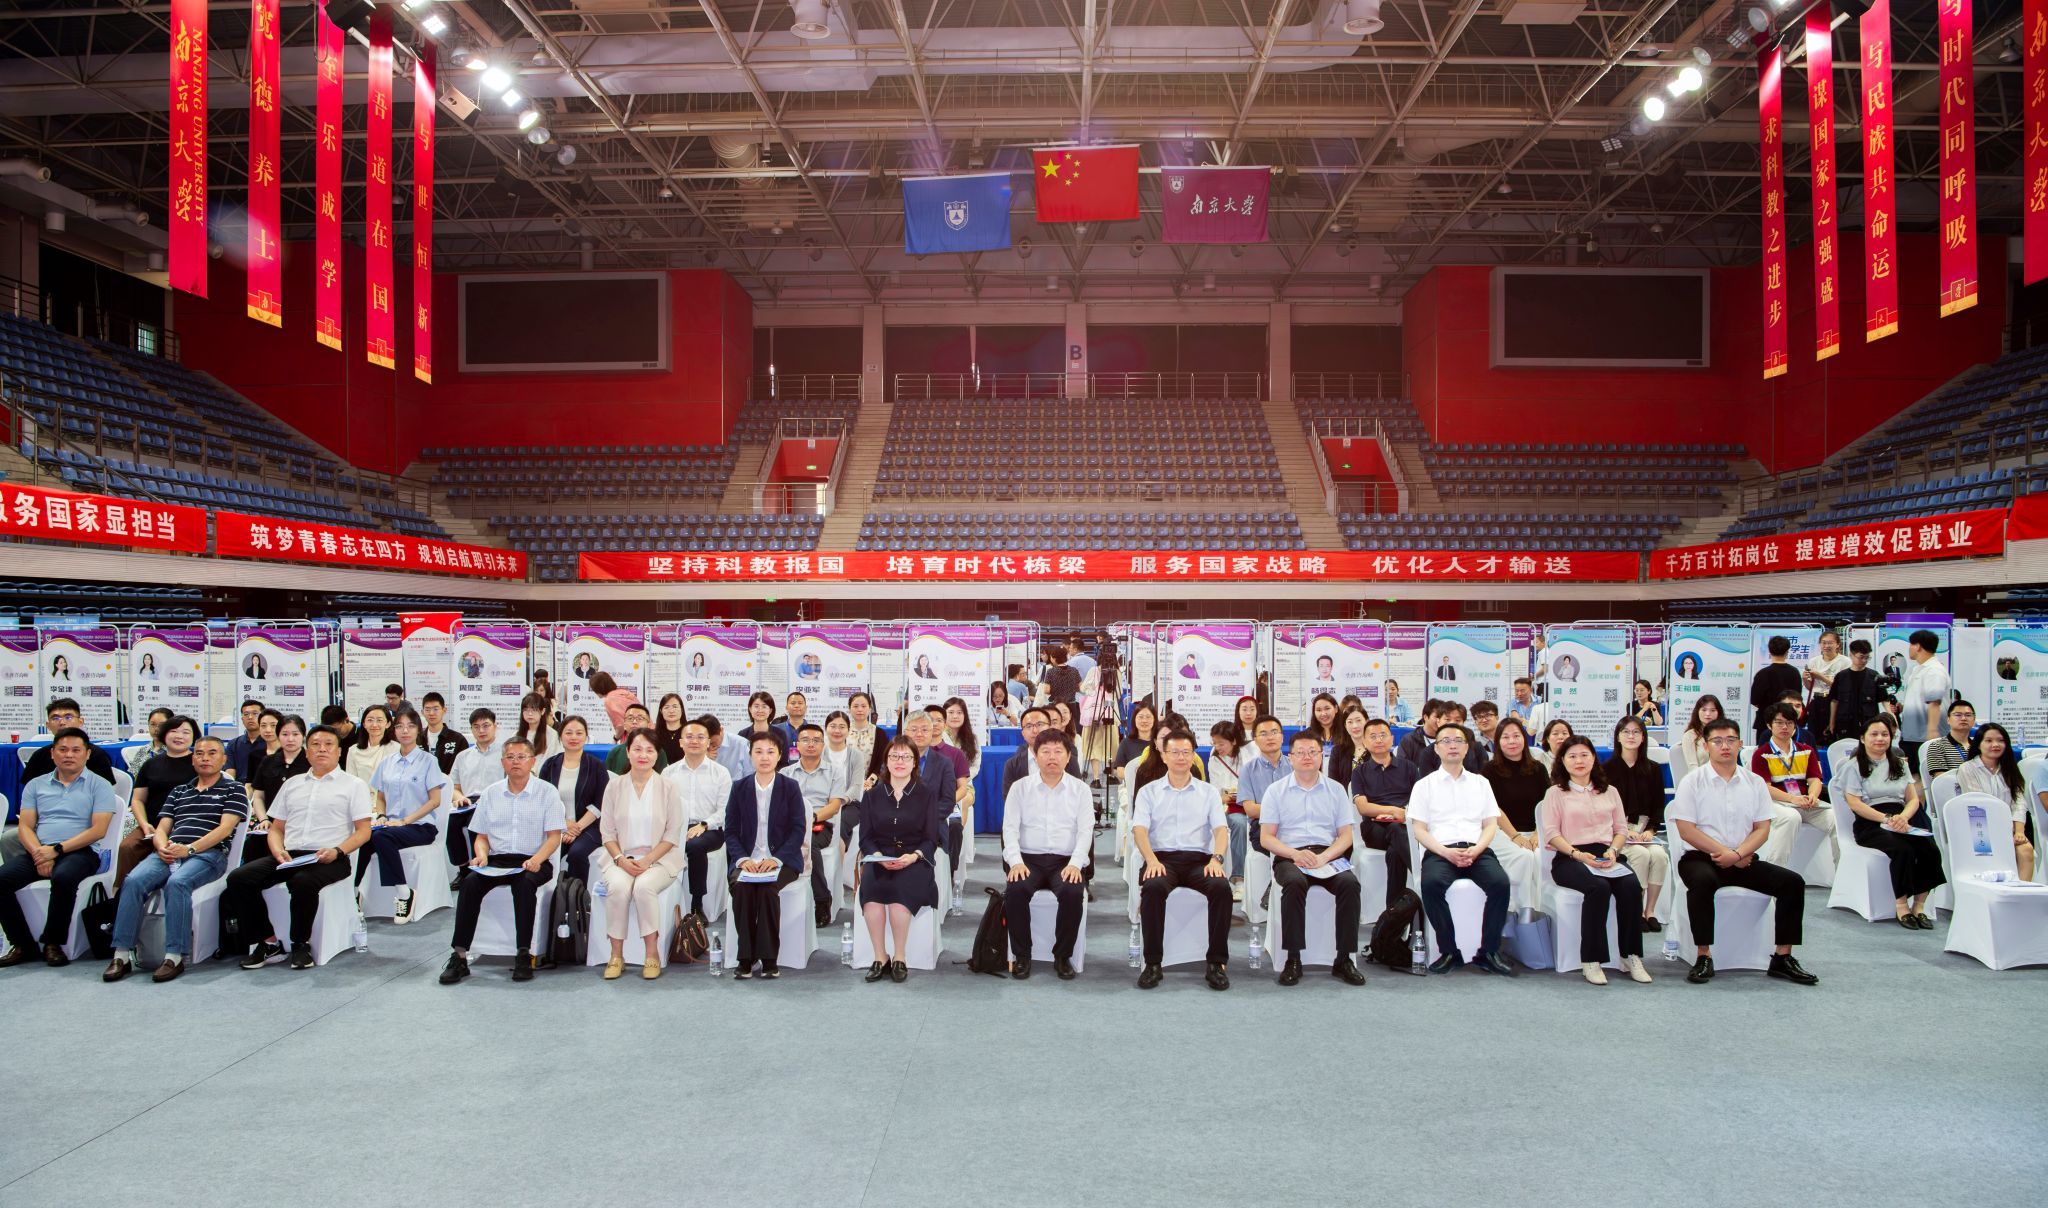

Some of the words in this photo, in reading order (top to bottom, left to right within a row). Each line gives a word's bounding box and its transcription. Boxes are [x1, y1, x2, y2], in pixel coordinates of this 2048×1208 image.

[192, 28, 204, 110] NANJING
[193, 115, 205, 226] UNIVERSITY
[371, 90, 388, 314] 吾道在国
[1813, 78, 1834, 305] 谋国家之强盛
[1867, 42, 1891, 281] 与民族共命运
[416, 122, 429, 332] 与世恒新
[1764, 117, 1782, 328] 求科教之进步
[1070, 345, 1082, 361] B
[250, 523, 406, 561] 筑梦青春志在四方
[418, 543, 518, 573] 规划启航职引未来
[648, 556, 845, 575] 坚持科教报国
[887, 556, 1086, 575] 培育时代栋梁
[1130, 556, 1328, 575] 服务国家战略
[1372, 556, 1572, 575] 优化人才输送
[1666, 542, 1779, 573] 千方百计拓岗位
[1795, 520, 1973, 562] 提速增效促就业
